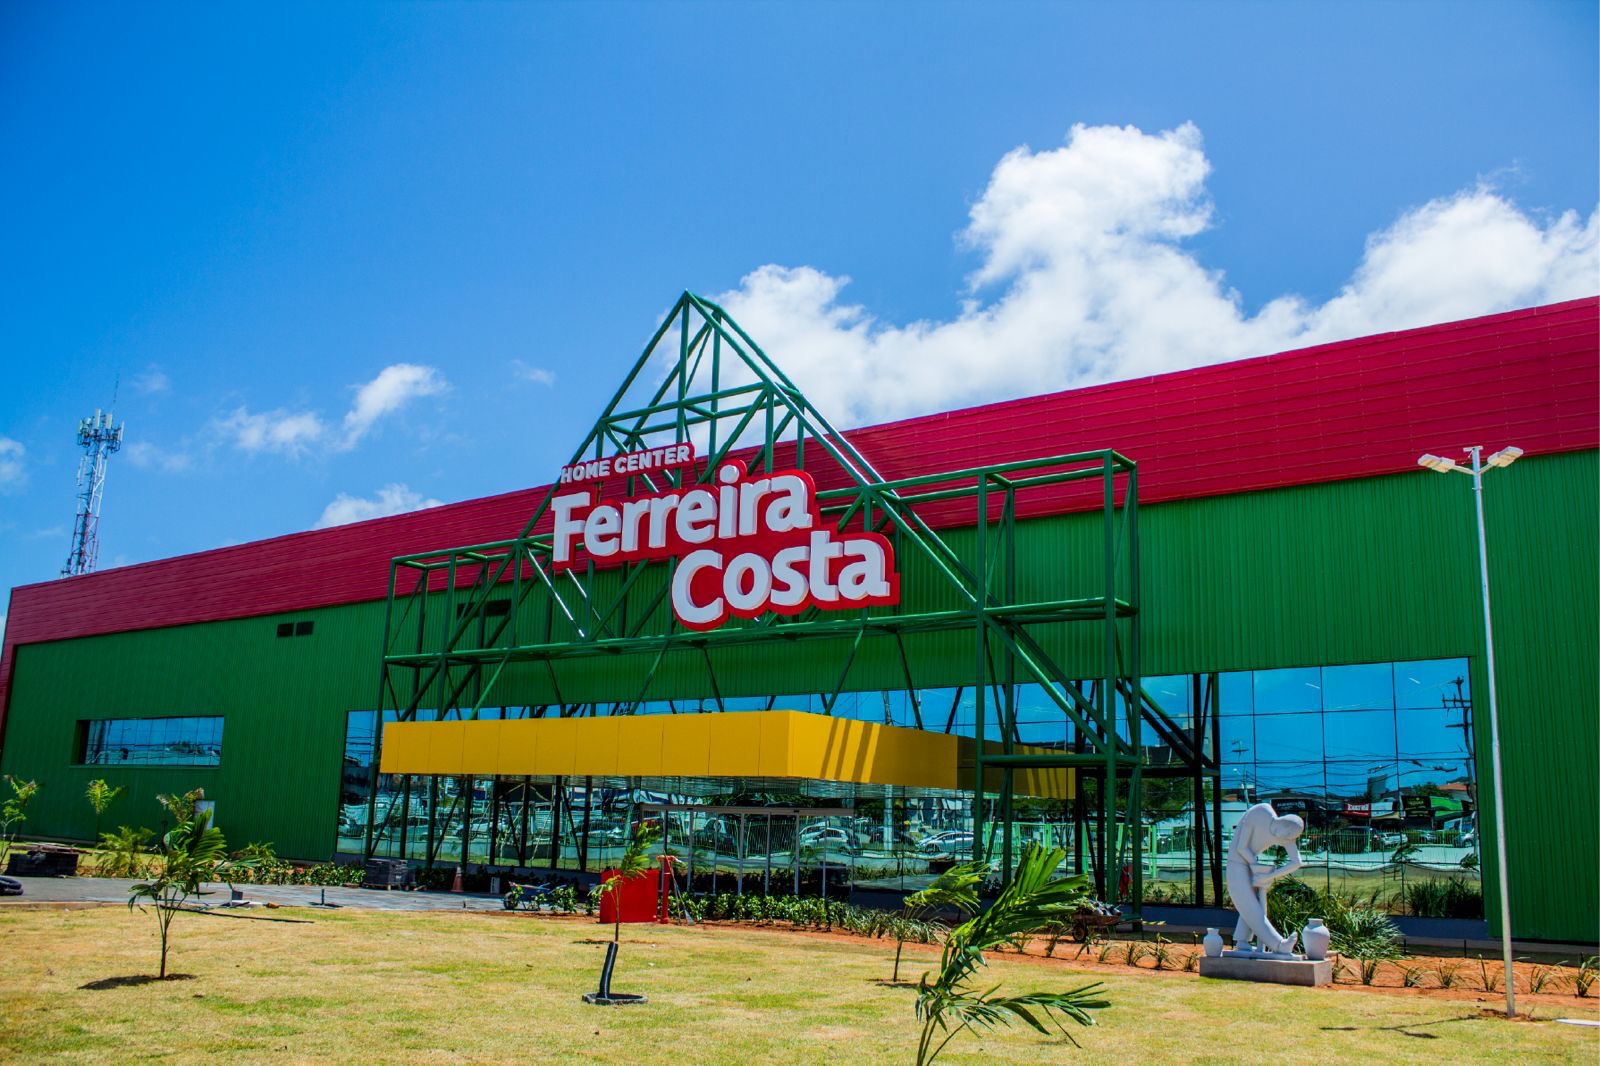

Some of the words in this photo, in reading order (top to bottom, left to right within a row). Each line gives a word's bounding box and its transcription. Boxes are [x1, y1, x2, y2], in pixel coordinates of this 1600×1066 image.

[560, 459, 611, 484] HOME
[614, 445, 690, 474] CENTER
[551, 464, 813, 562] Ferreira
[671, 530, 891, 624] Costa
